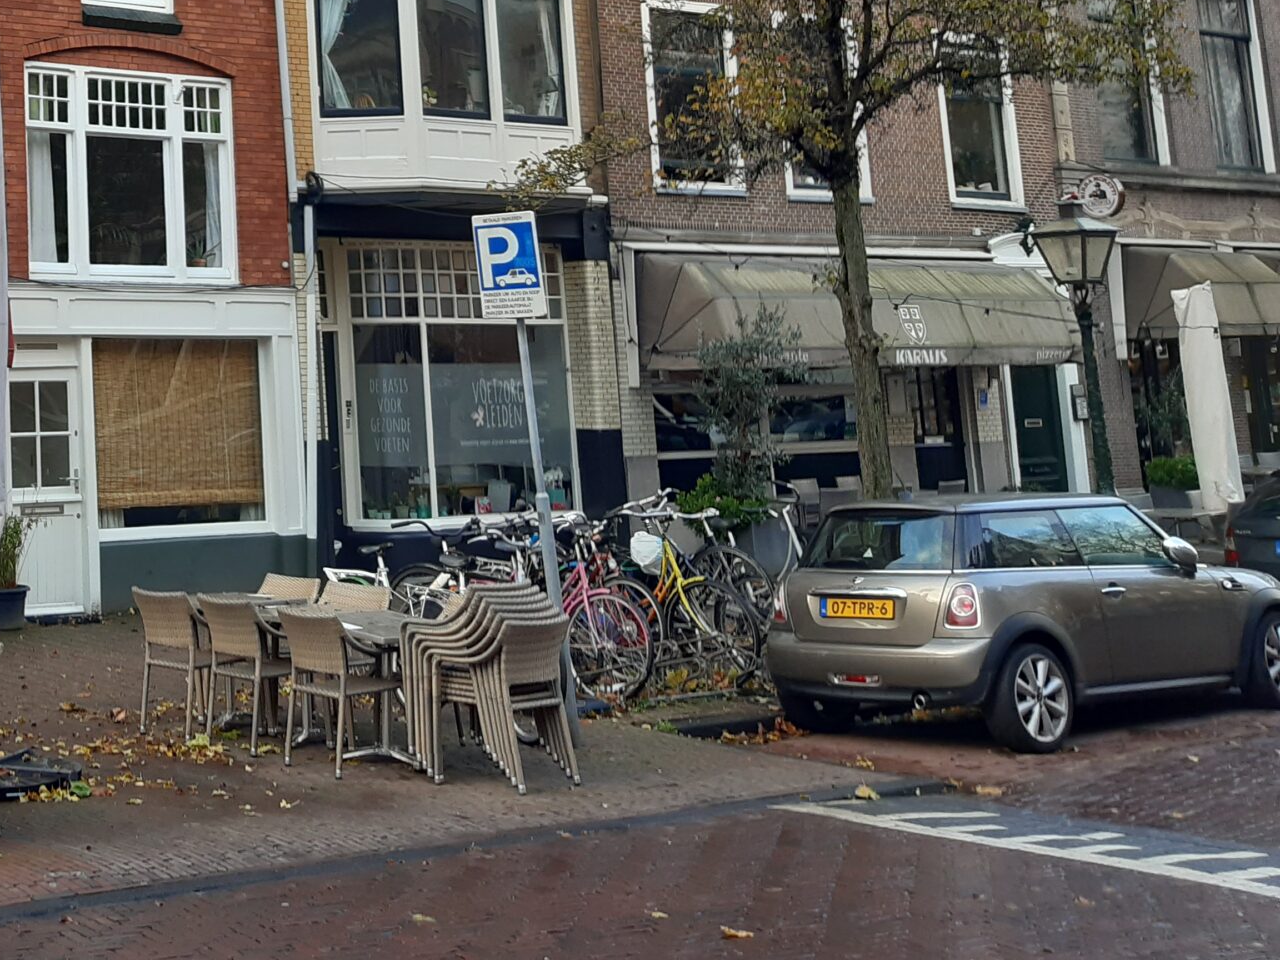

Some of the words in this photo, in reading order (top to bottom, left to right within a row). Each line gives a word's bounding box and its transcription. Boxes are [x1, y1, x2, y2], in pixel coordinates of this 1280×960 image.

[477, 227, 519, 288] P
[369, 378, 379, 393] DE
[382, 378, 409, 394] BASIS
[472, 378, 524, 404] VOETZORG
[377, 397, 402, 413] VOOR
[485, 403, 522, 428] LEIDEN
[370, 416, 411, 433] GEZONDE
[374, 436, 410, 452] VOETEN
[831, 601, 888, 615] 07-TPR-6
